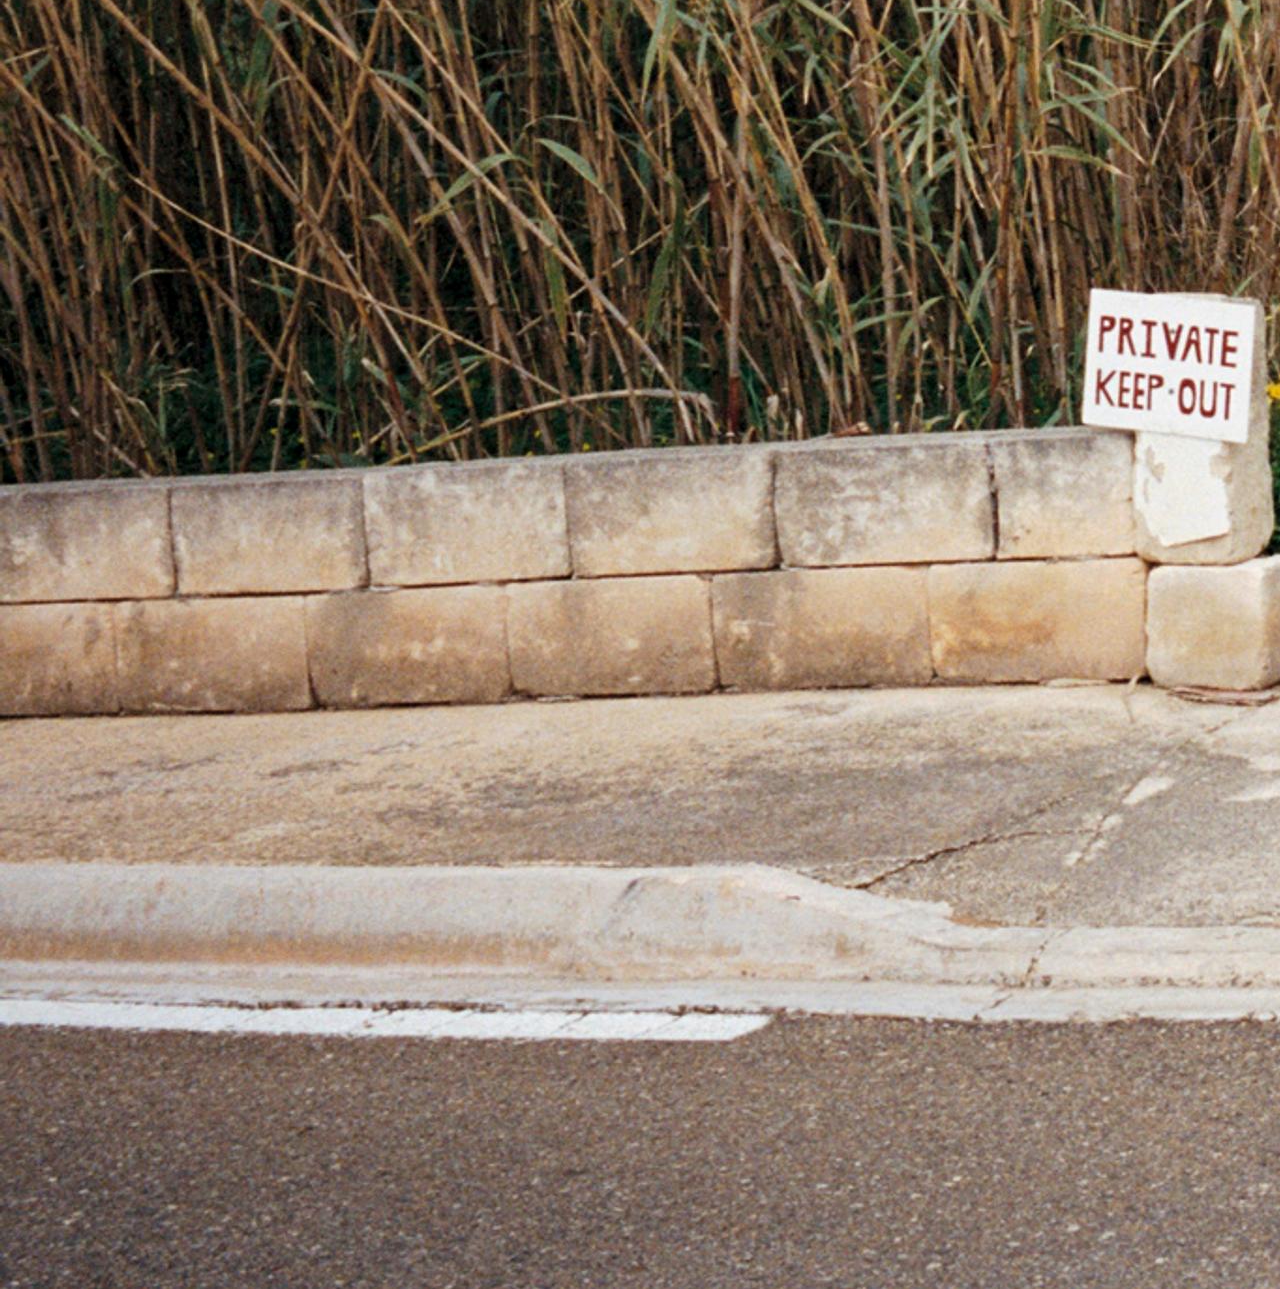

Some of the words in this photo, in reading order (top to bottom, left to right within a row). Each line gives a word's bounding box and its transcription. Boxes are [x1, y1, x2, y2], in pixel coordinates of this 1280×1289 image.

[1098, 315, 1240, 368] PRIVATE
[1095, 368, 1164, 411] KEEP
[1178, 378, 1236, 421] OUT
